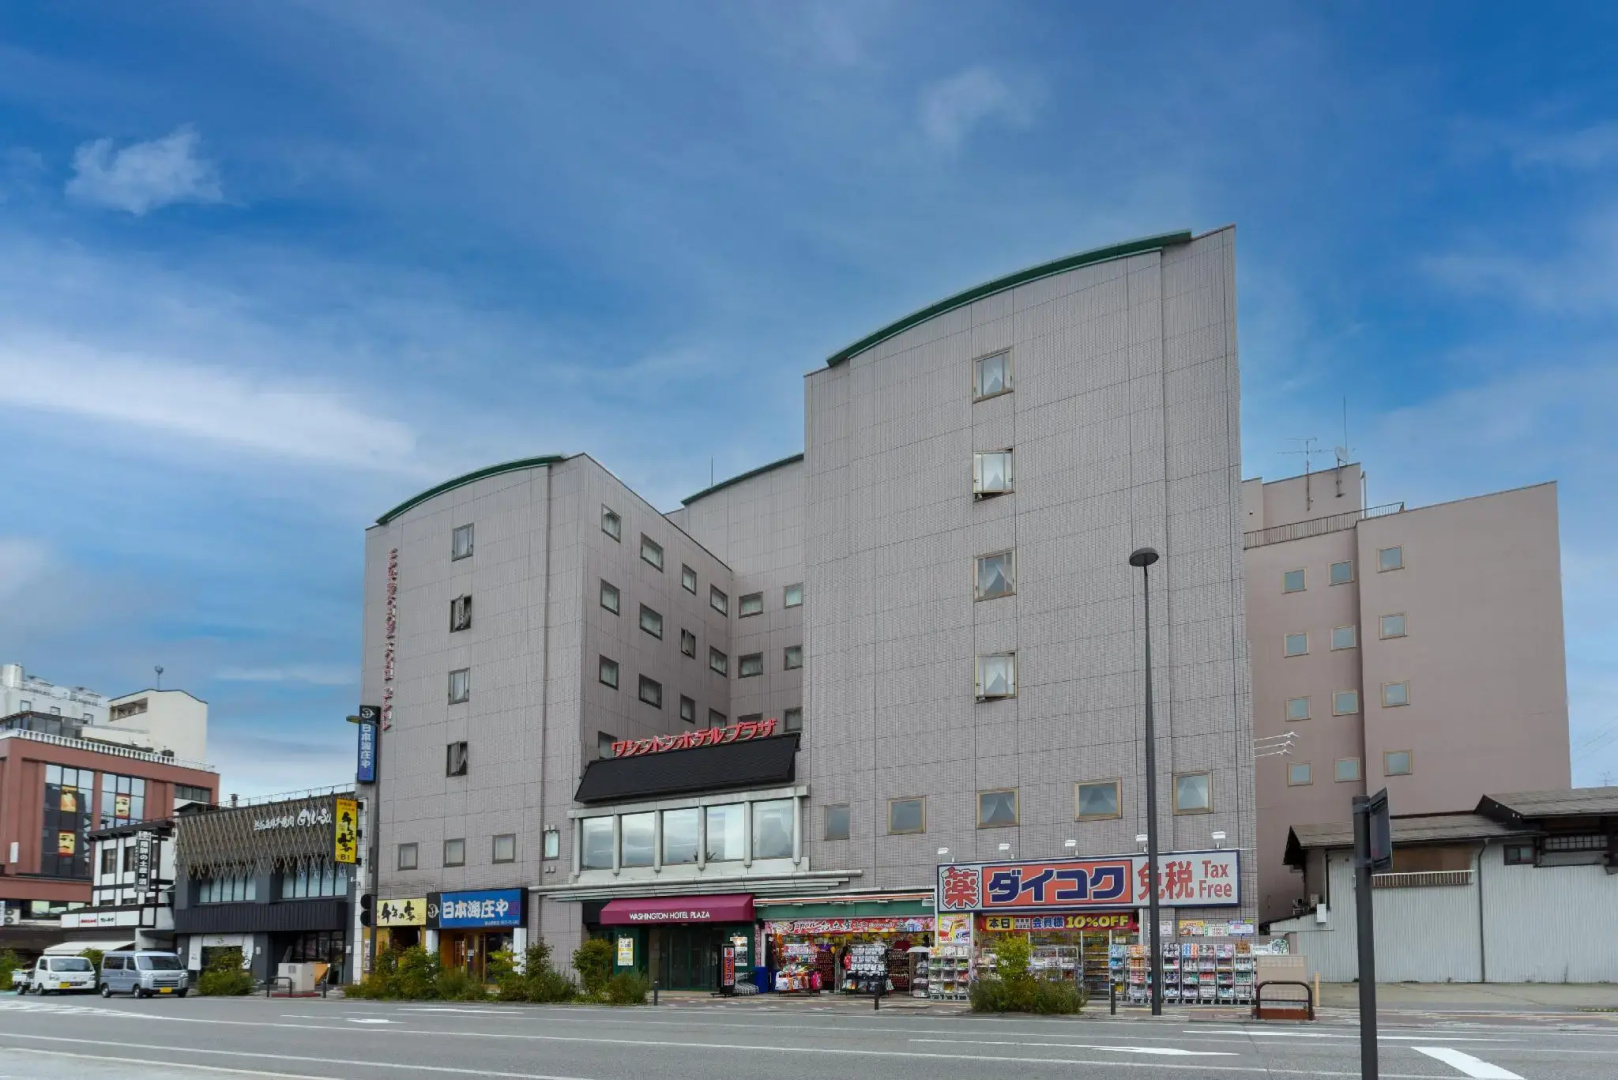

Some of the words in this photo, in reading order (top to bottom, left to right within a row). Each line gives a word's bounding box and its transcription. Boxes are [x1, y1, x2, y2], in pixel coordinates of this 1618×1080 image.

[611, 718, 778, 758] ワシントンホテルプラザ
[1202, 860, 1230, 878] Tax
[942, 866, 979, 908] 薬
[988, 866, 1125, 903] ダイコク
[1199, 880, 1232, 898] Free
[442, 899, 509, 919] 日本海庄や
[629, 912, 668, 920] WASHINGTON
[669, 911, 688, 919] HOTEL
[690, 911, 710, 919] PLAZA
[988, 917, 1010, 929] 本日
[1066, 915, 1129, 928] 10%OFF
